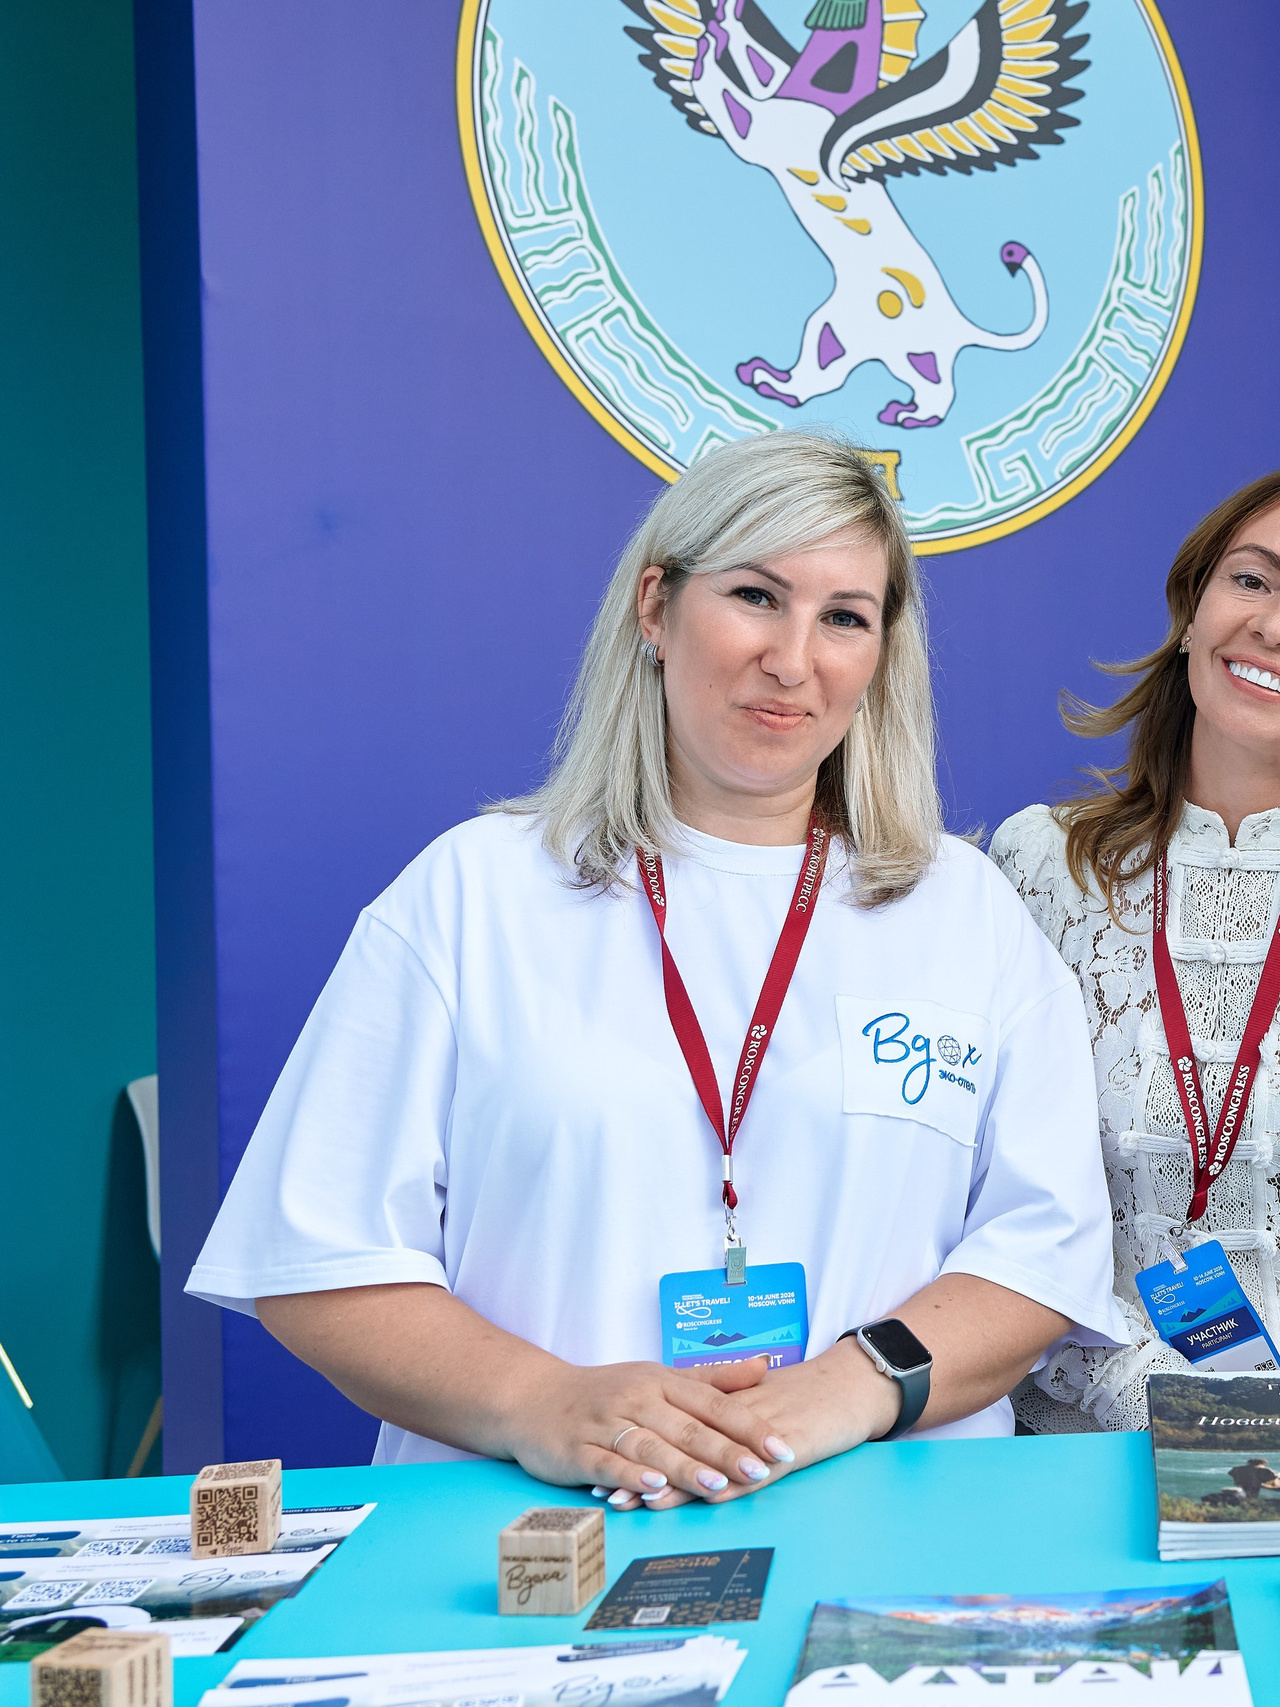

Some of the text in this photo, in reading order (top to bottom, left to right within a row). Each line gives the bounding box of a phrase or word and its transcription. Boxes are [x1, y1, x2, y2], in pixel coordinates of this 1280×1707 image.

[796, 836, 825, 913] РОСКОНГРЕСС
[1182, 1072, 1208, 1170] ROSCONGRESS
[1215, 1064, 1251, 1161] ROSCONGRESS
[682, 1299, 701, 1308] LET'S
[701, 1297, 731, 1307] TRAVEL!
[683, 1319, 722, 1328] ROSCONGRESS
[1186, 1317, 1239, 1346] УЧАСТНИК
[1201, 1332, 1233, 1349] PARTICIPANT
[1199, 1415, 1280, 1426] Новая
